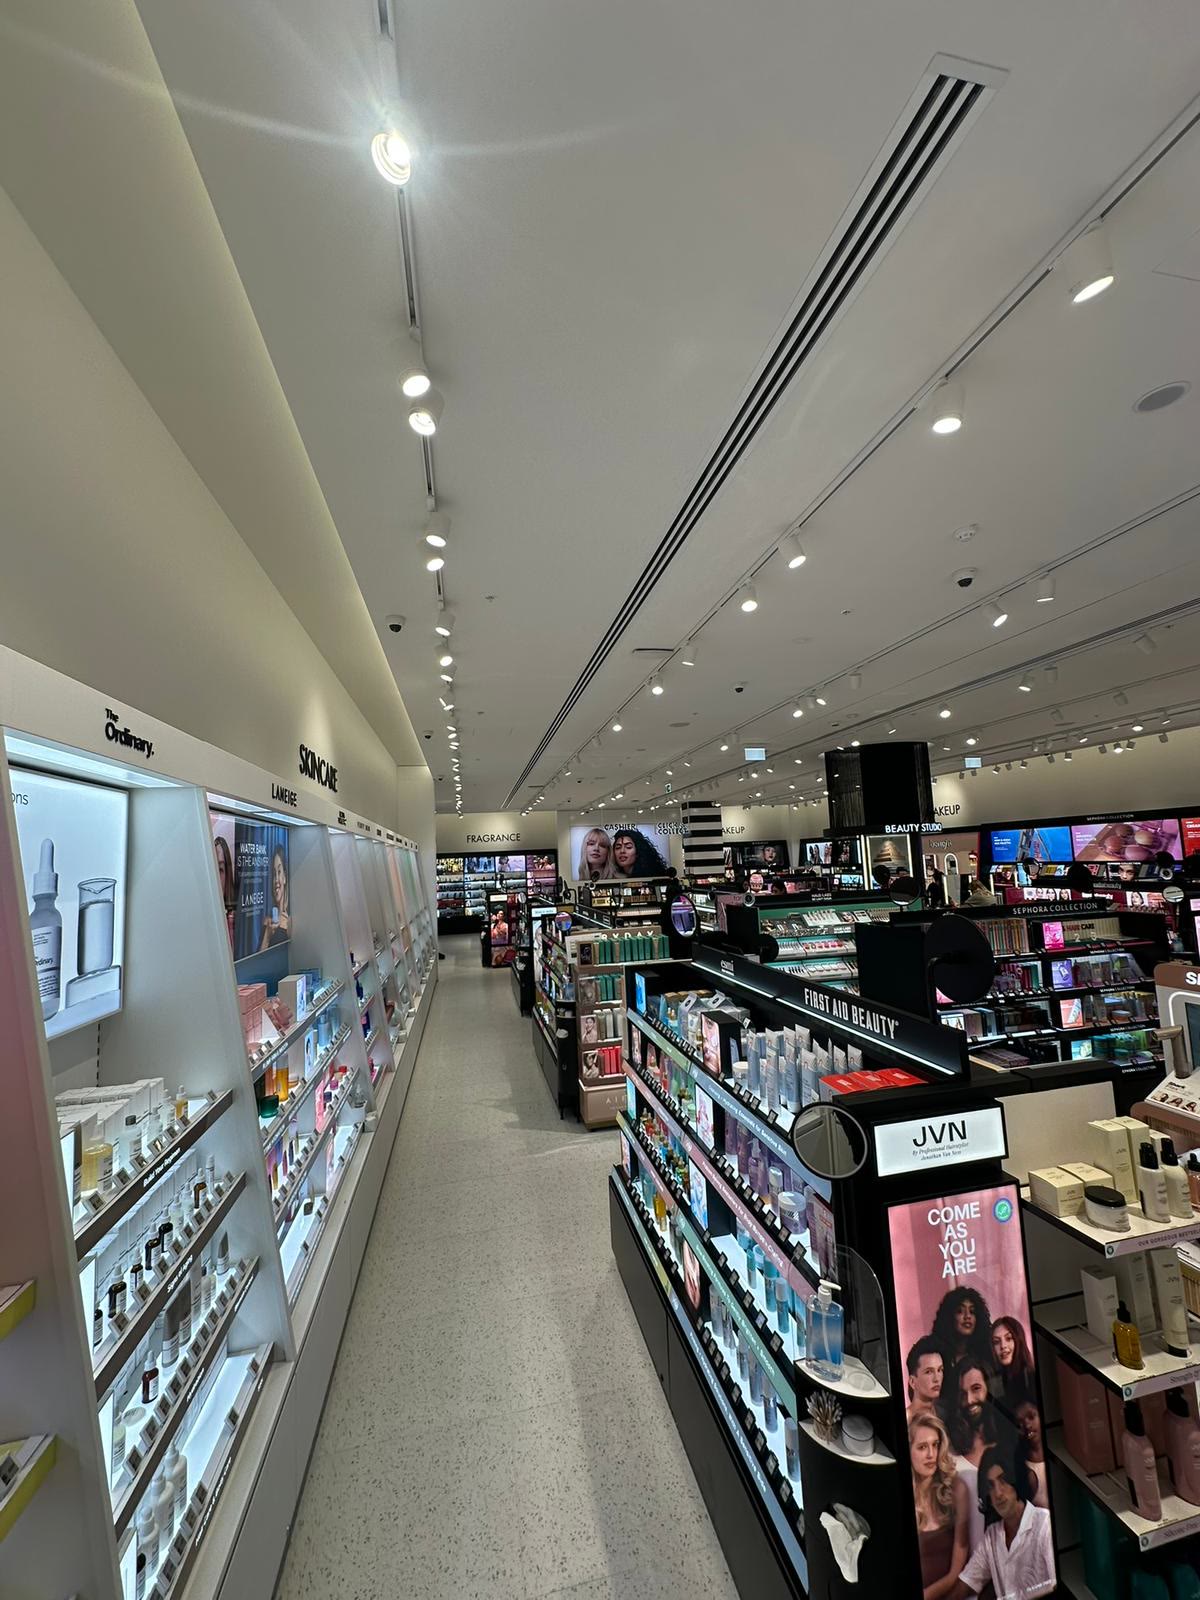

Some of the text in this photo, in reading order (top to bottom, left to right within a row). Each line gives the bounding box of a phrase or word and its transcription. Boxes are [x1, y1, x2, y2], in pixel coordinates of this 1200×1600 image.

[105, 708, 119, 723] The
[105, 722, 155, 759] Ordinary.
[299, 744, 338, 793] SKINCARE
[272, 783, 297, 807] LANEIGE
[934, 804, 960, 816] AKEUP
[604, 823, 637, 831] CASHIER
[721, 826, 745, 834] AKEUP
[885, 824, 920, 833] BEAUTY
[466, 833, 521, 844] FRAGRANCE
[240, 843, 267, 855] WATER BANK
[1012, 902, 1098, 915] SEPHORA COLLECTION
[804, 987, 830, 1014] FIRST
[832, 998, 849, 1021] AID
[912, 1120, 967, 1147] JVN
[919, 1146, 946, 1155] Professional
[927, 1201, 981, 1226] COME
[944, 1221, 968, 1241] AS
[938, 1238, 975, 1260] YOU
[942, 1256, 977, 1279] ARE
